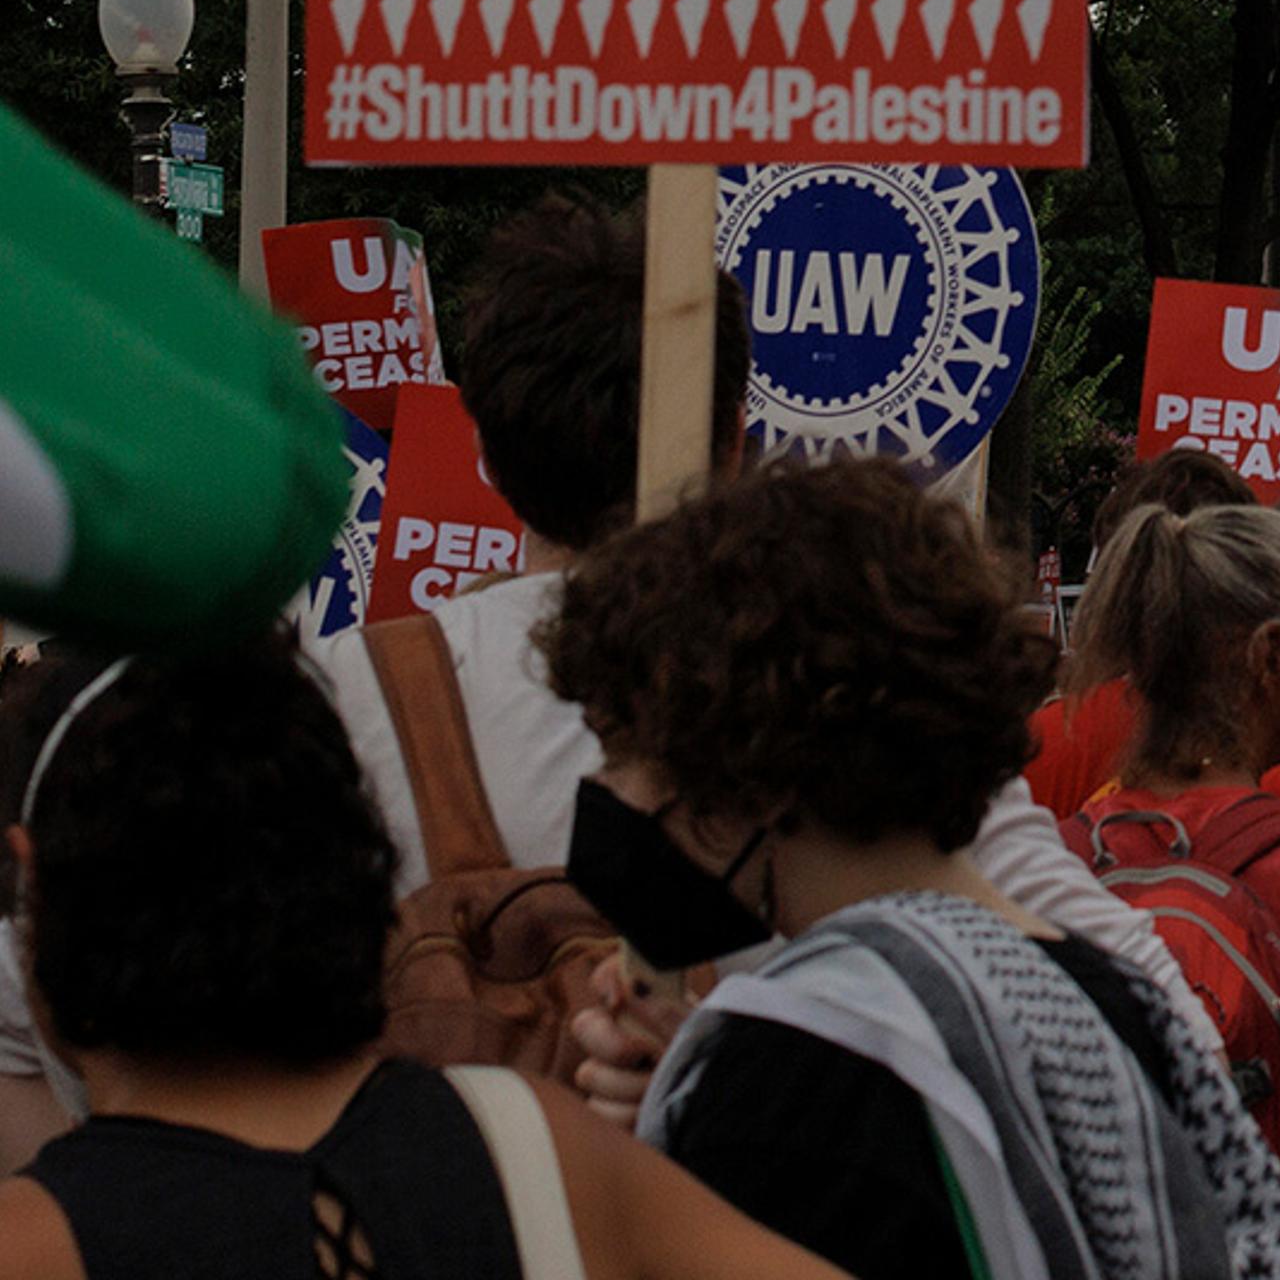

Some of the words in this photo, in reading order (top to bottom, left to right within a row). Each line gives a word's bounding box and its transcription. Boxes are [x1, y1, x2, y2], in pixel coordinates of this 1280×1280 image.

[324, 63, 1062, 147] #ShutItDown4Palestine
[716, 181, 769, 254] AEROSPACE
[906, 178, 957, 257] IMPLEMENT
[752, 247, 912, 337] UAW
[941, 263, 960, 340] WORKERS
[931, 344, 946, 364] OF
[874, 369, 929, 418] AMERICA
